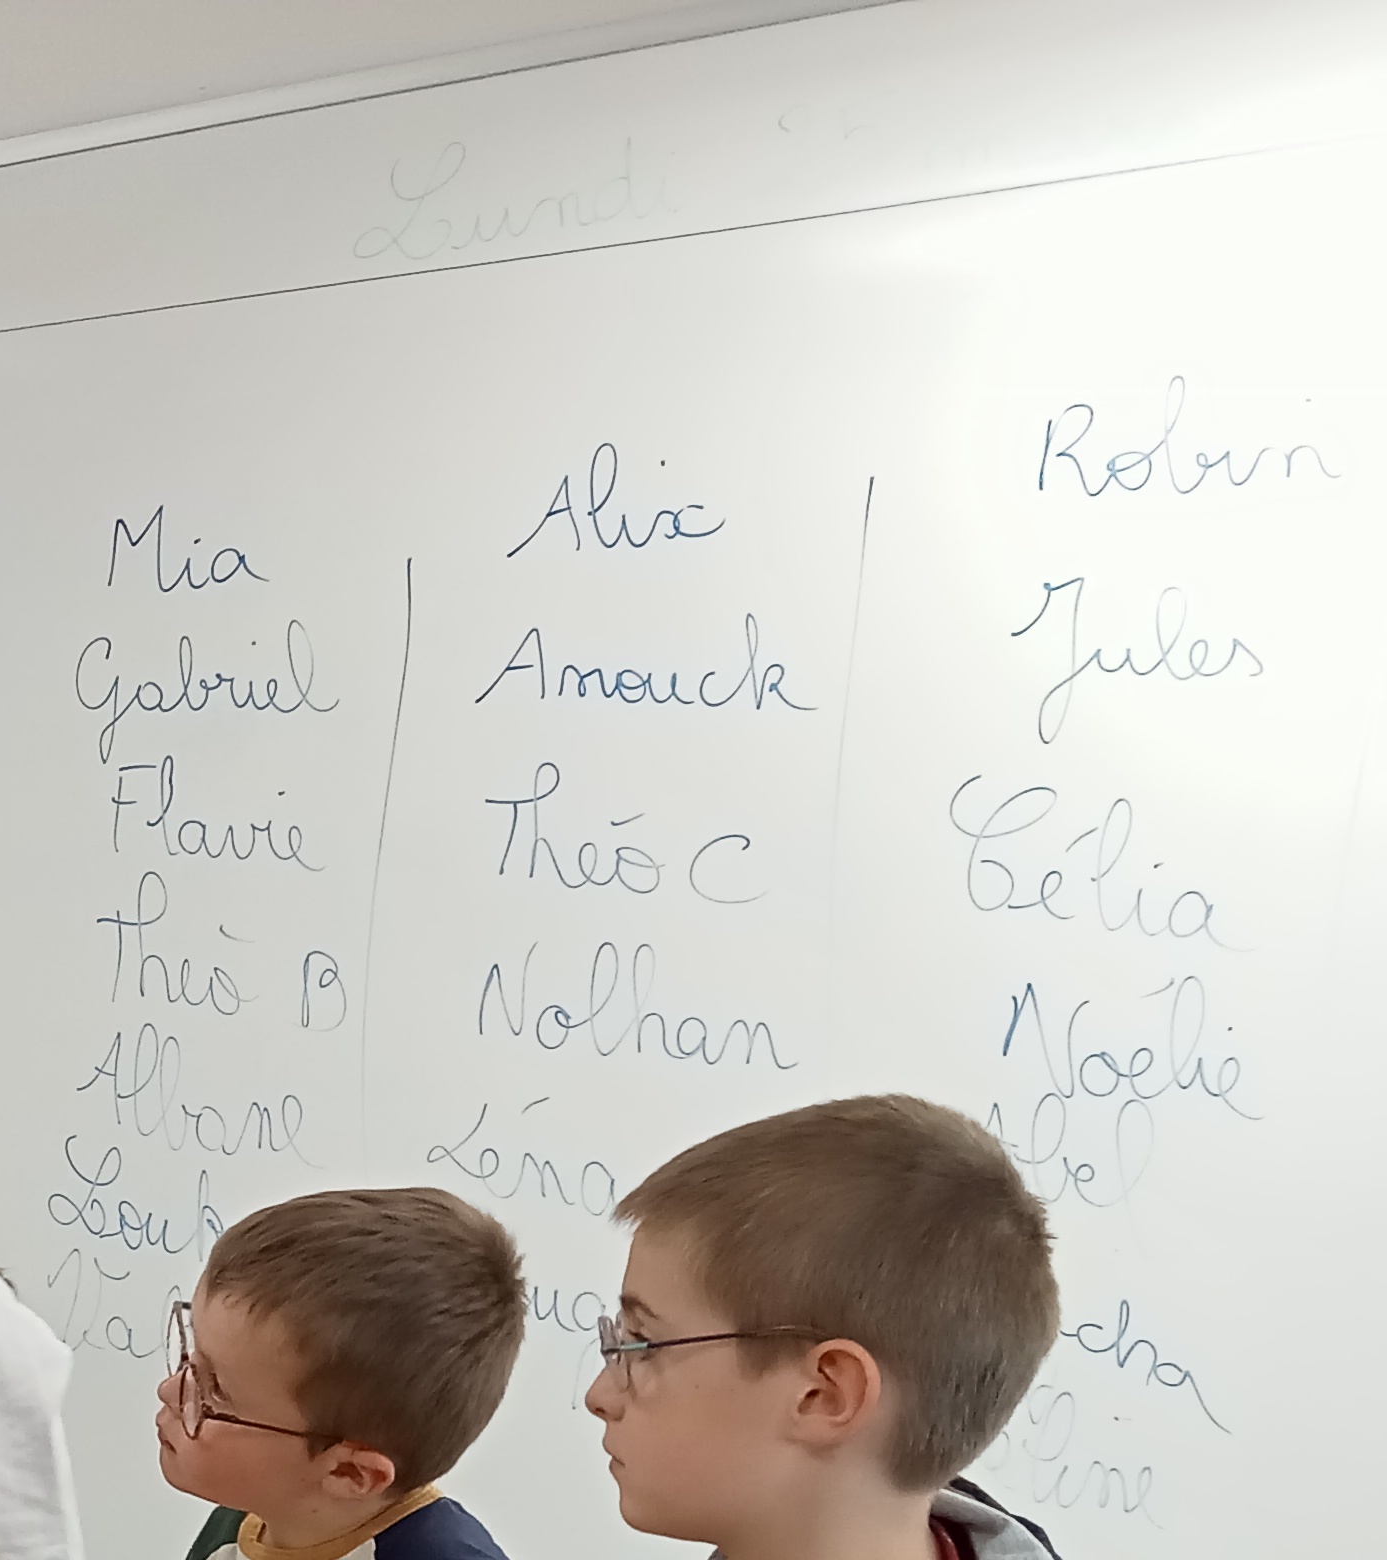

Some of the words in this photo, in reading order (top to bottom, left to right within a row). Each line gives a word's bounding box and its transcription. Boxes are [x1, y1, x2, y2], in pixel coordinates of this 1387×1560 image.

[1038, 375, 1343, 497] Robin
[107, 505, 270, 593] Mia
[506, 442, 726, 558] Alix
[75, 619, 340, 765] Gabriel
[474, 612, 820, 711] Anouck
[1010, 576, 1265, 745] Jules
[111, 755, 327, 872] Flavie
[689, 834, 770, 905] C
[949, 774, 1259, 953] Célia
[293, 951, 347, 1032] B
[478, 941, 799, 1070] Nolhan
[1002, 976, 1266, 1121] Noélie
